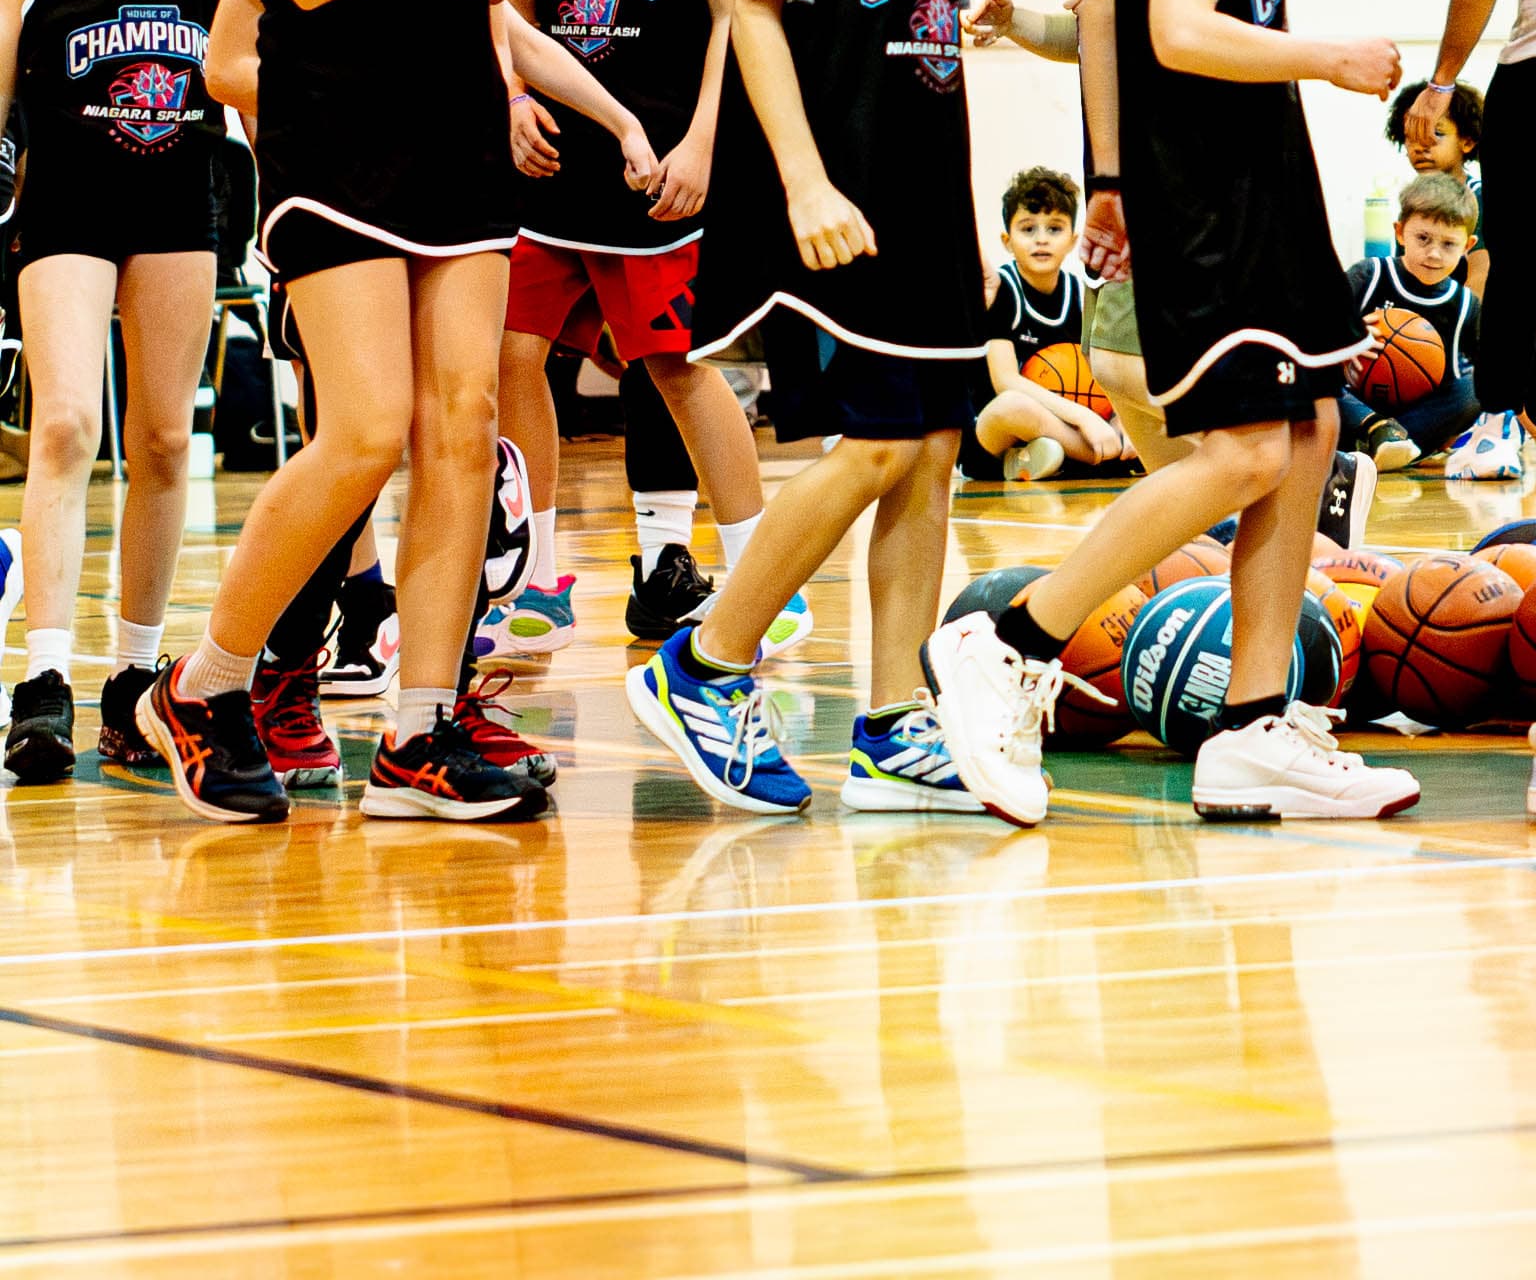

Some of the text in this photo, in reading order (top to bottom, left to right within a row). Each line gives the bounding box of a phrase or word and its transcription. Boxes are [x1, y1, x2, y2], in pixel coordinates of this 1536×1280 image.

[589, 25, 641, 38] SPLASH
[82, 104, 205, 123] NIAGARA SPLASH
[1133, 607, 1196, 713] Wilson
[1183, 651, 1232, 705] NBA
